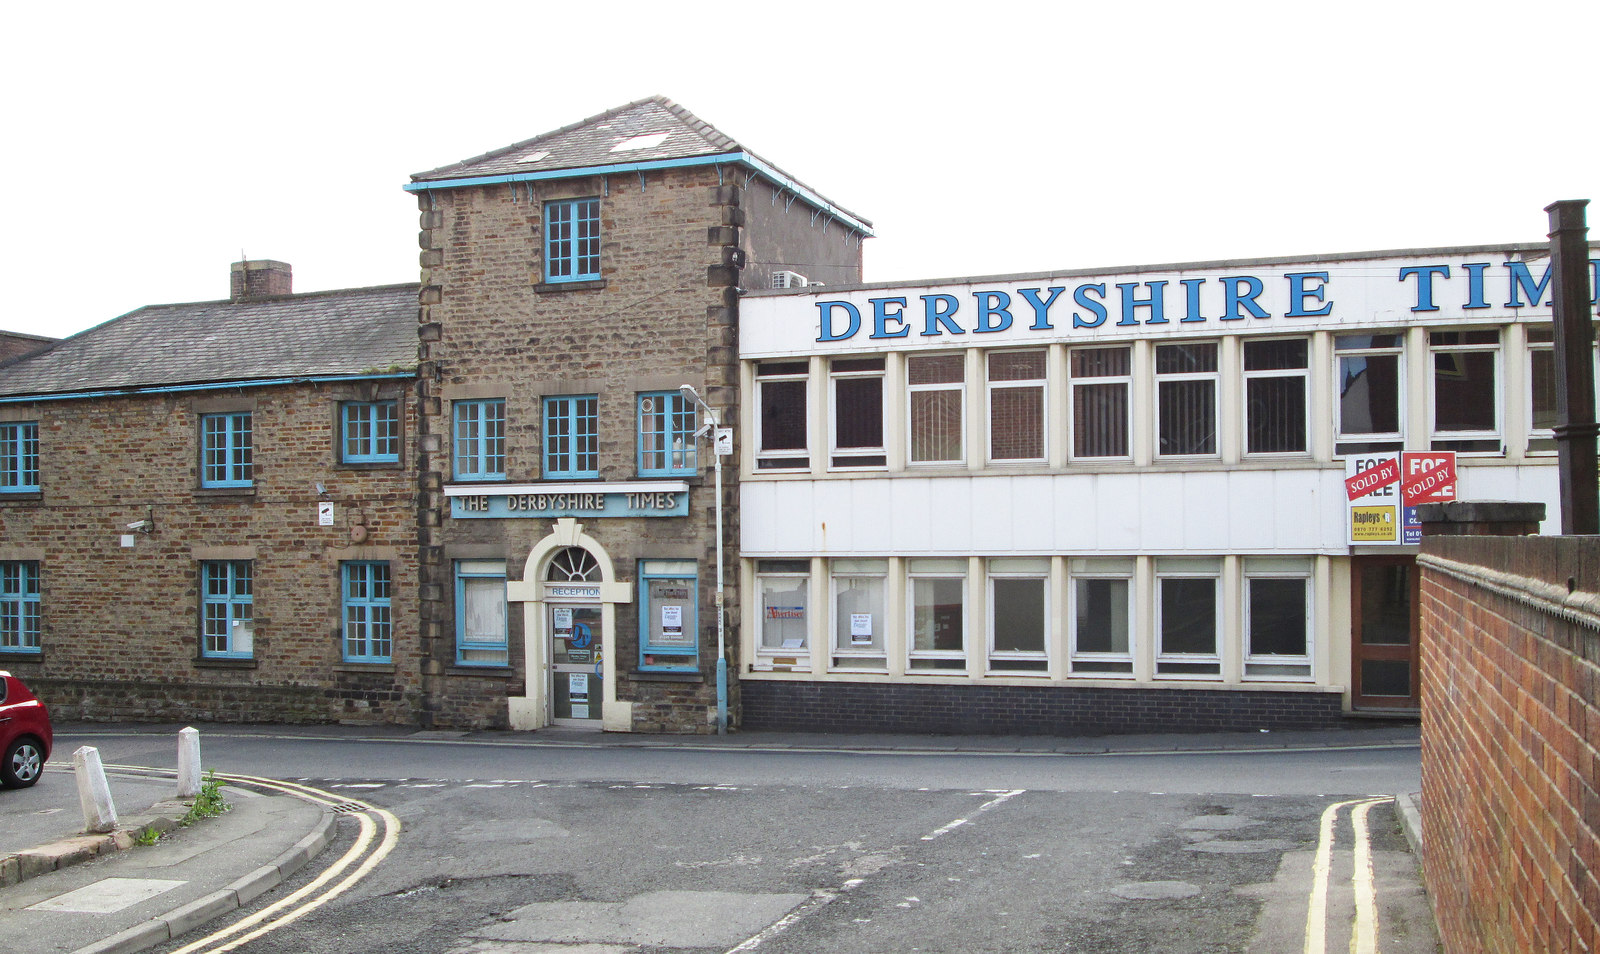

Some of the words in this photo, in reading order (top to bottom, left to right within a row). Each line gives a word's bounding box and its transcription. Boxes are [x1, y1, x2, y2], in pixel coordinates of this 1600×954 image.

[815, 271, 1334, 342] DERBYSHIRE
[1399, 259, 1600, 312] TIM
[1351, 473, 1379, 493] SOLD
[1381, 466, 1393, 480] BY
[1407, 476, 1436, 498] SOLD
[1436, 467, 1449, 482] BY
[459, 495, 488, 511] THE
[507, 493, 604, 511] DERBYSHIRE
[625, 492, 676, 509] TIMES
[1354, 512, 1380, 524] Rapleys
[552, 588, 600, 596] RECEPTION
[767, 606, 804, 618] Advertiser
